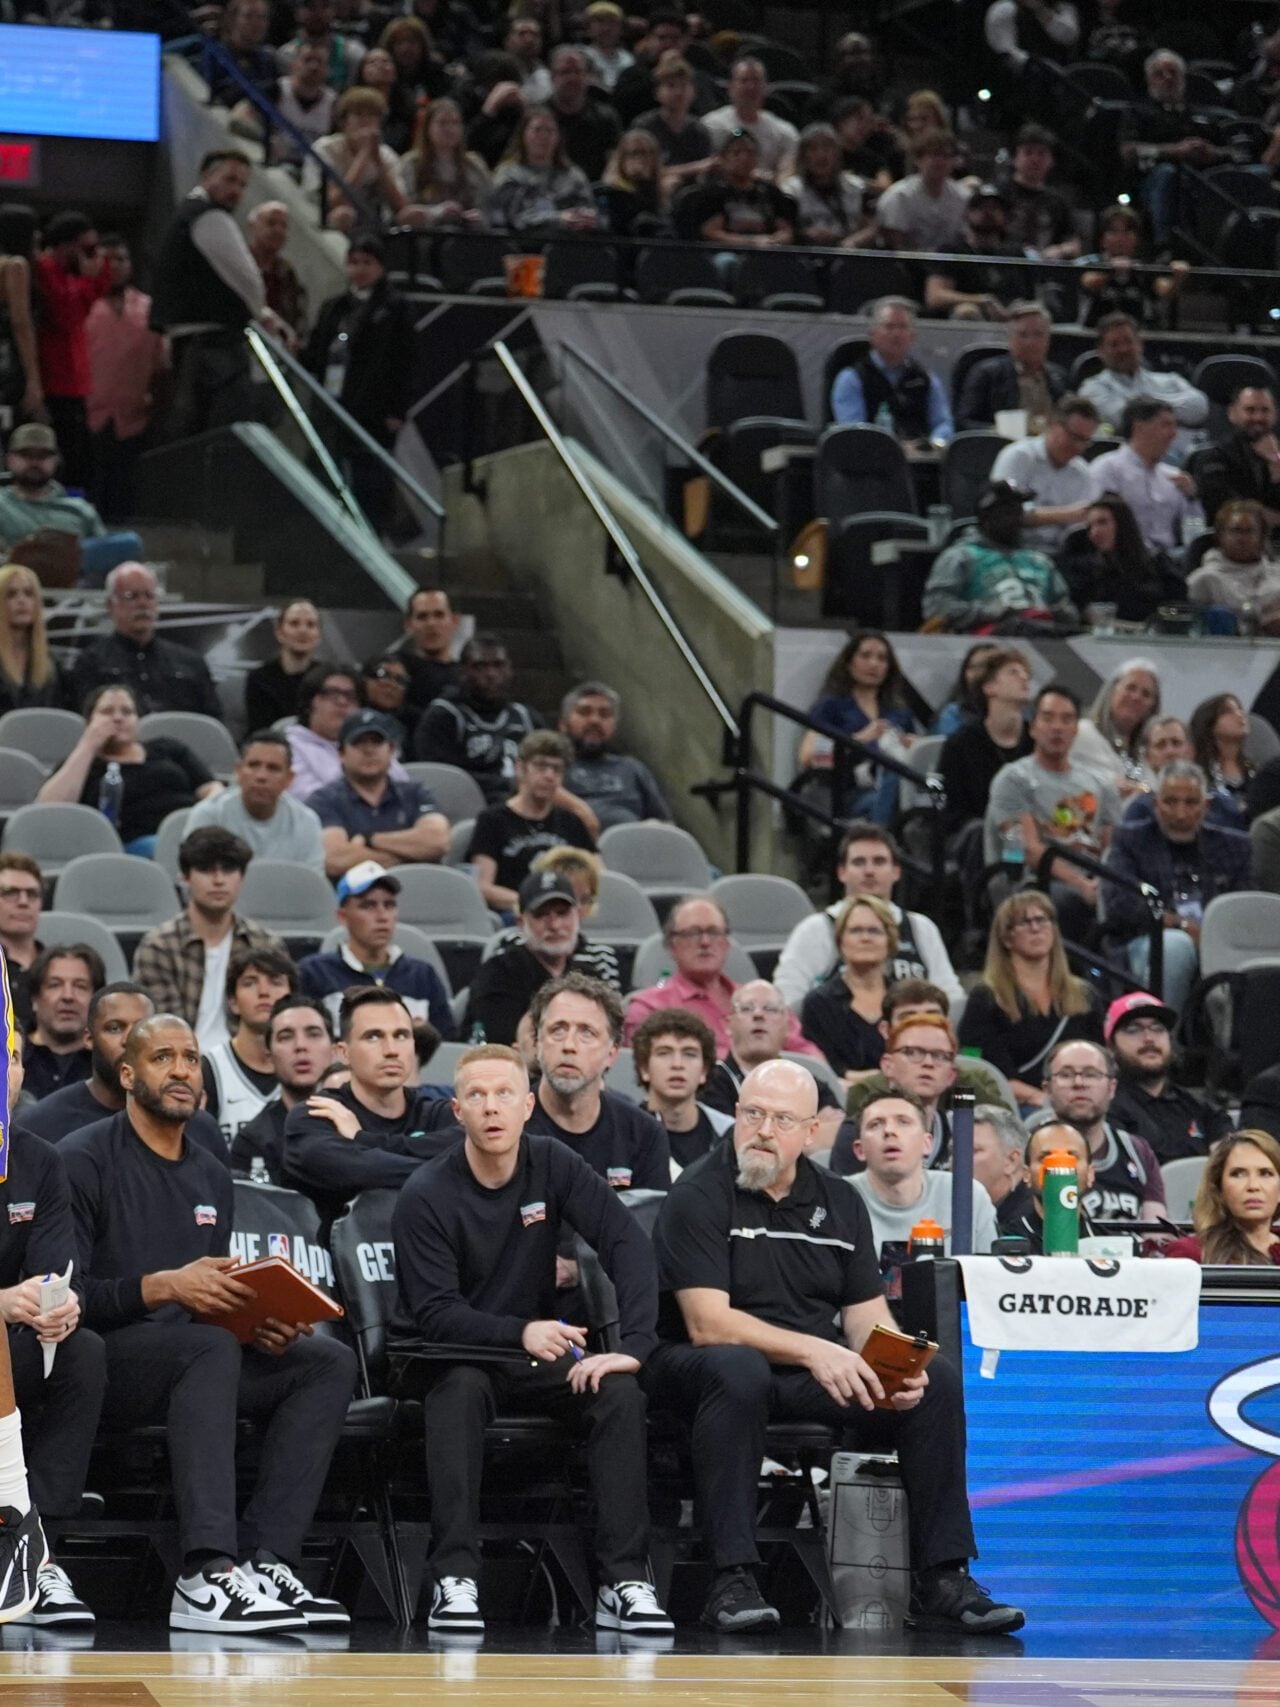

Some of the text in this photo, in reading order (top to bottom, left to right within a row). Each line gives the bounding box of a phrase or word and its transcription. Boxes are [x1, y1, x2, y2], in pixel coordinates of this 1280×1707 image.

[1059, 1185, 1078, 1210] G
[1081, 1190, 1139, 1219] PUR
[230, 1231, 261, 1268] HE
[356, 1242, 396, 1282] GE
[998, 1293, 1149, 1318] GATORADE
